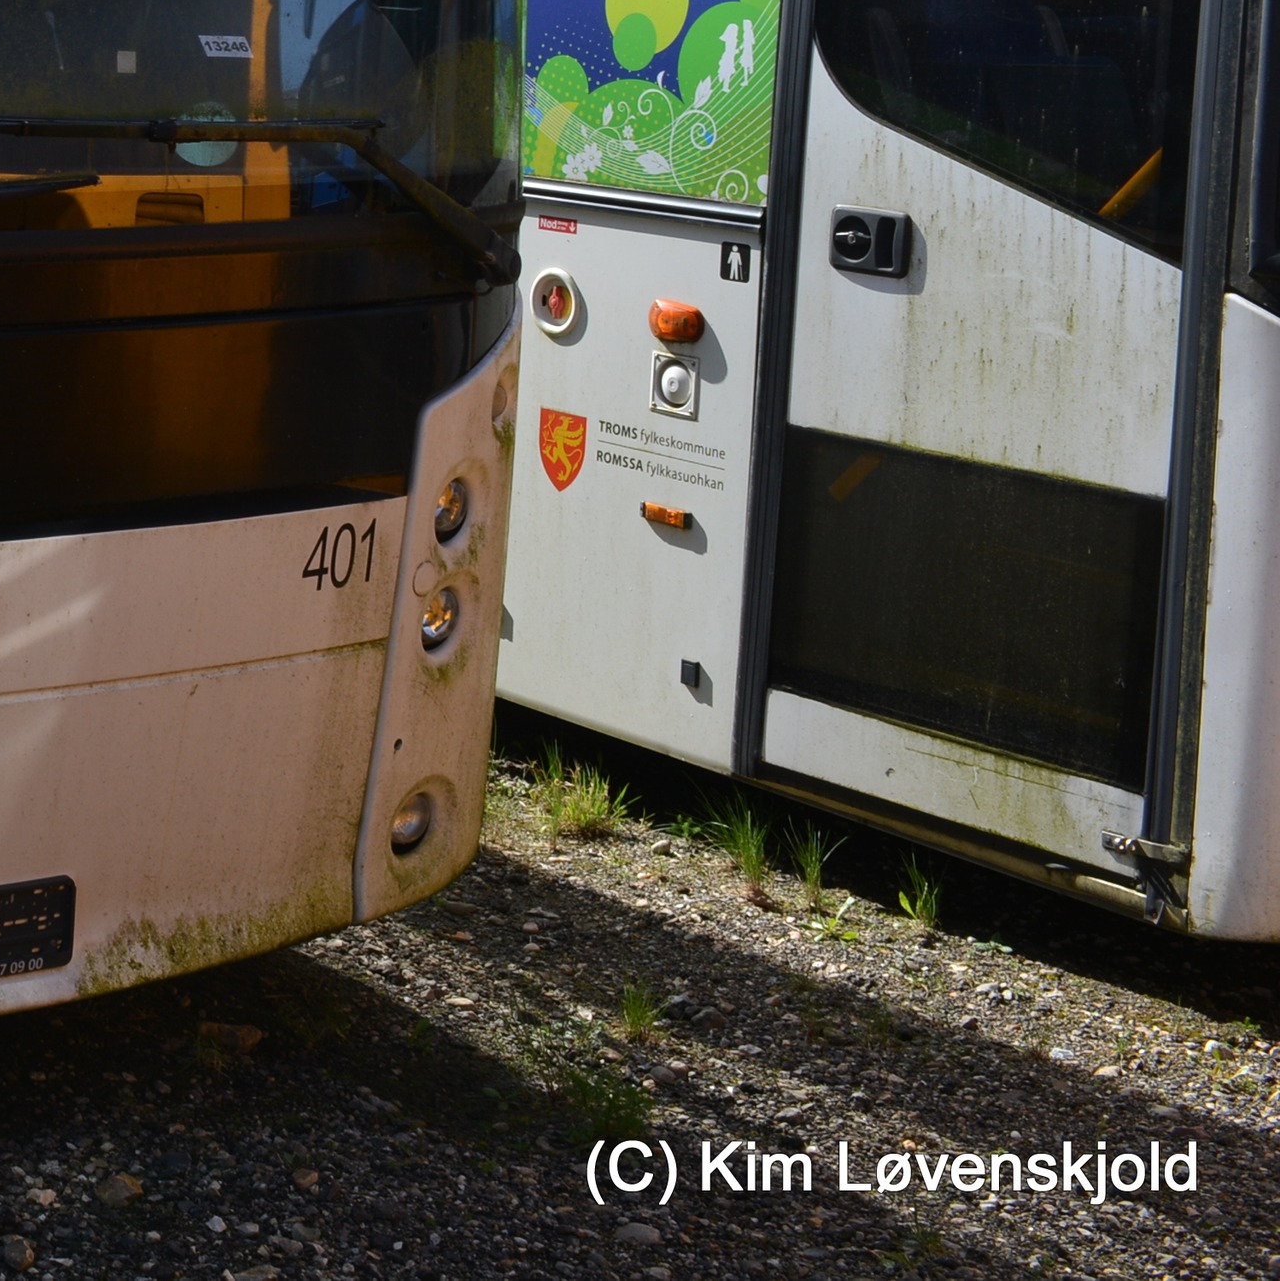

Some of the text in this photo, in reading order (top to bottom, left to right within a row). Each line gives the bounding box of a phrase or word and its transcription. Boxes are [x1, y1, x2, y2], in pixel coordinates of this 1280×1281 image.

[204, 40, 249, 53] 13246
[599, 420, 726, 460] TROMS fylkeskommune
[596, 450, 724, 491] ROMSSA fylkkasuohkan
[302, 518, 377, 591] 401
[10, 960, 26, 974] 09
[28, 957, 44, 971] 00
